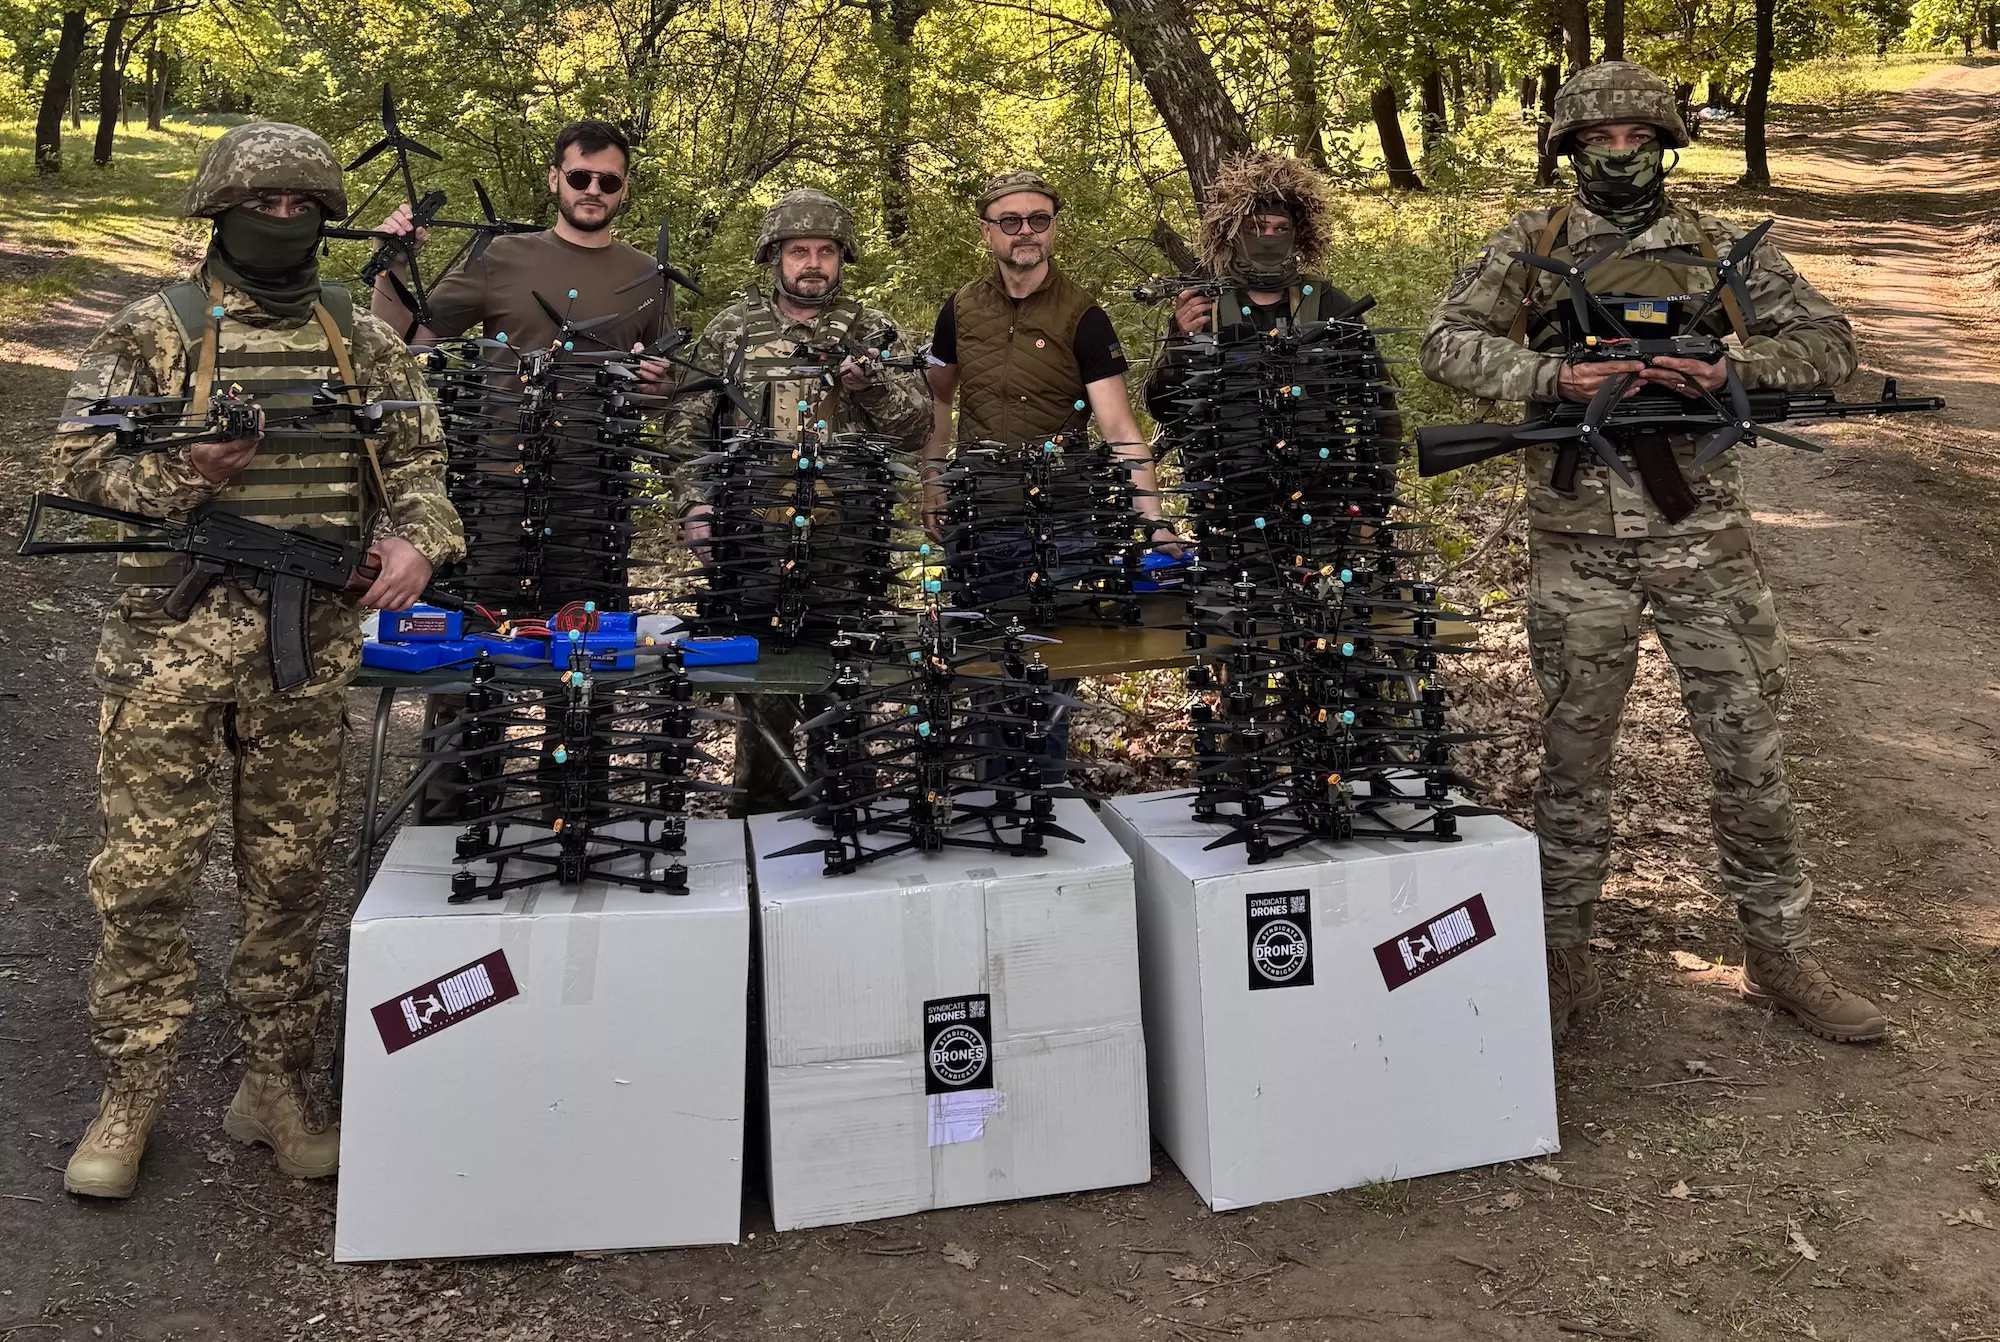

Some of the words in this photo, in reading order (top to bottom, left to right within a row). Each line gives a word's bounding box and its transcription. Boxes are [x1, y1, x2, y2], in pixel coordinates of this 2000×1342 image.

[1250, 897, 1287, 907] SYNDICATE
[1250, 905, 1288, 917] DRONES
[1261, 925, 1298, 940] SYNDICATE
[1256, 943, 1304, 958] DRONES
[1263, 960, 1299, 975] SYNDICATE
[928, 1002, 965, 1014] SYNDICATE
[928, 1010, 966, 1024] DRONES
[939, 1030, 977, 1046] SYNDICATE
[933, 1047, 983, 1063] DRONES
[940, 1065, 977, 1080] SYNDICATE
